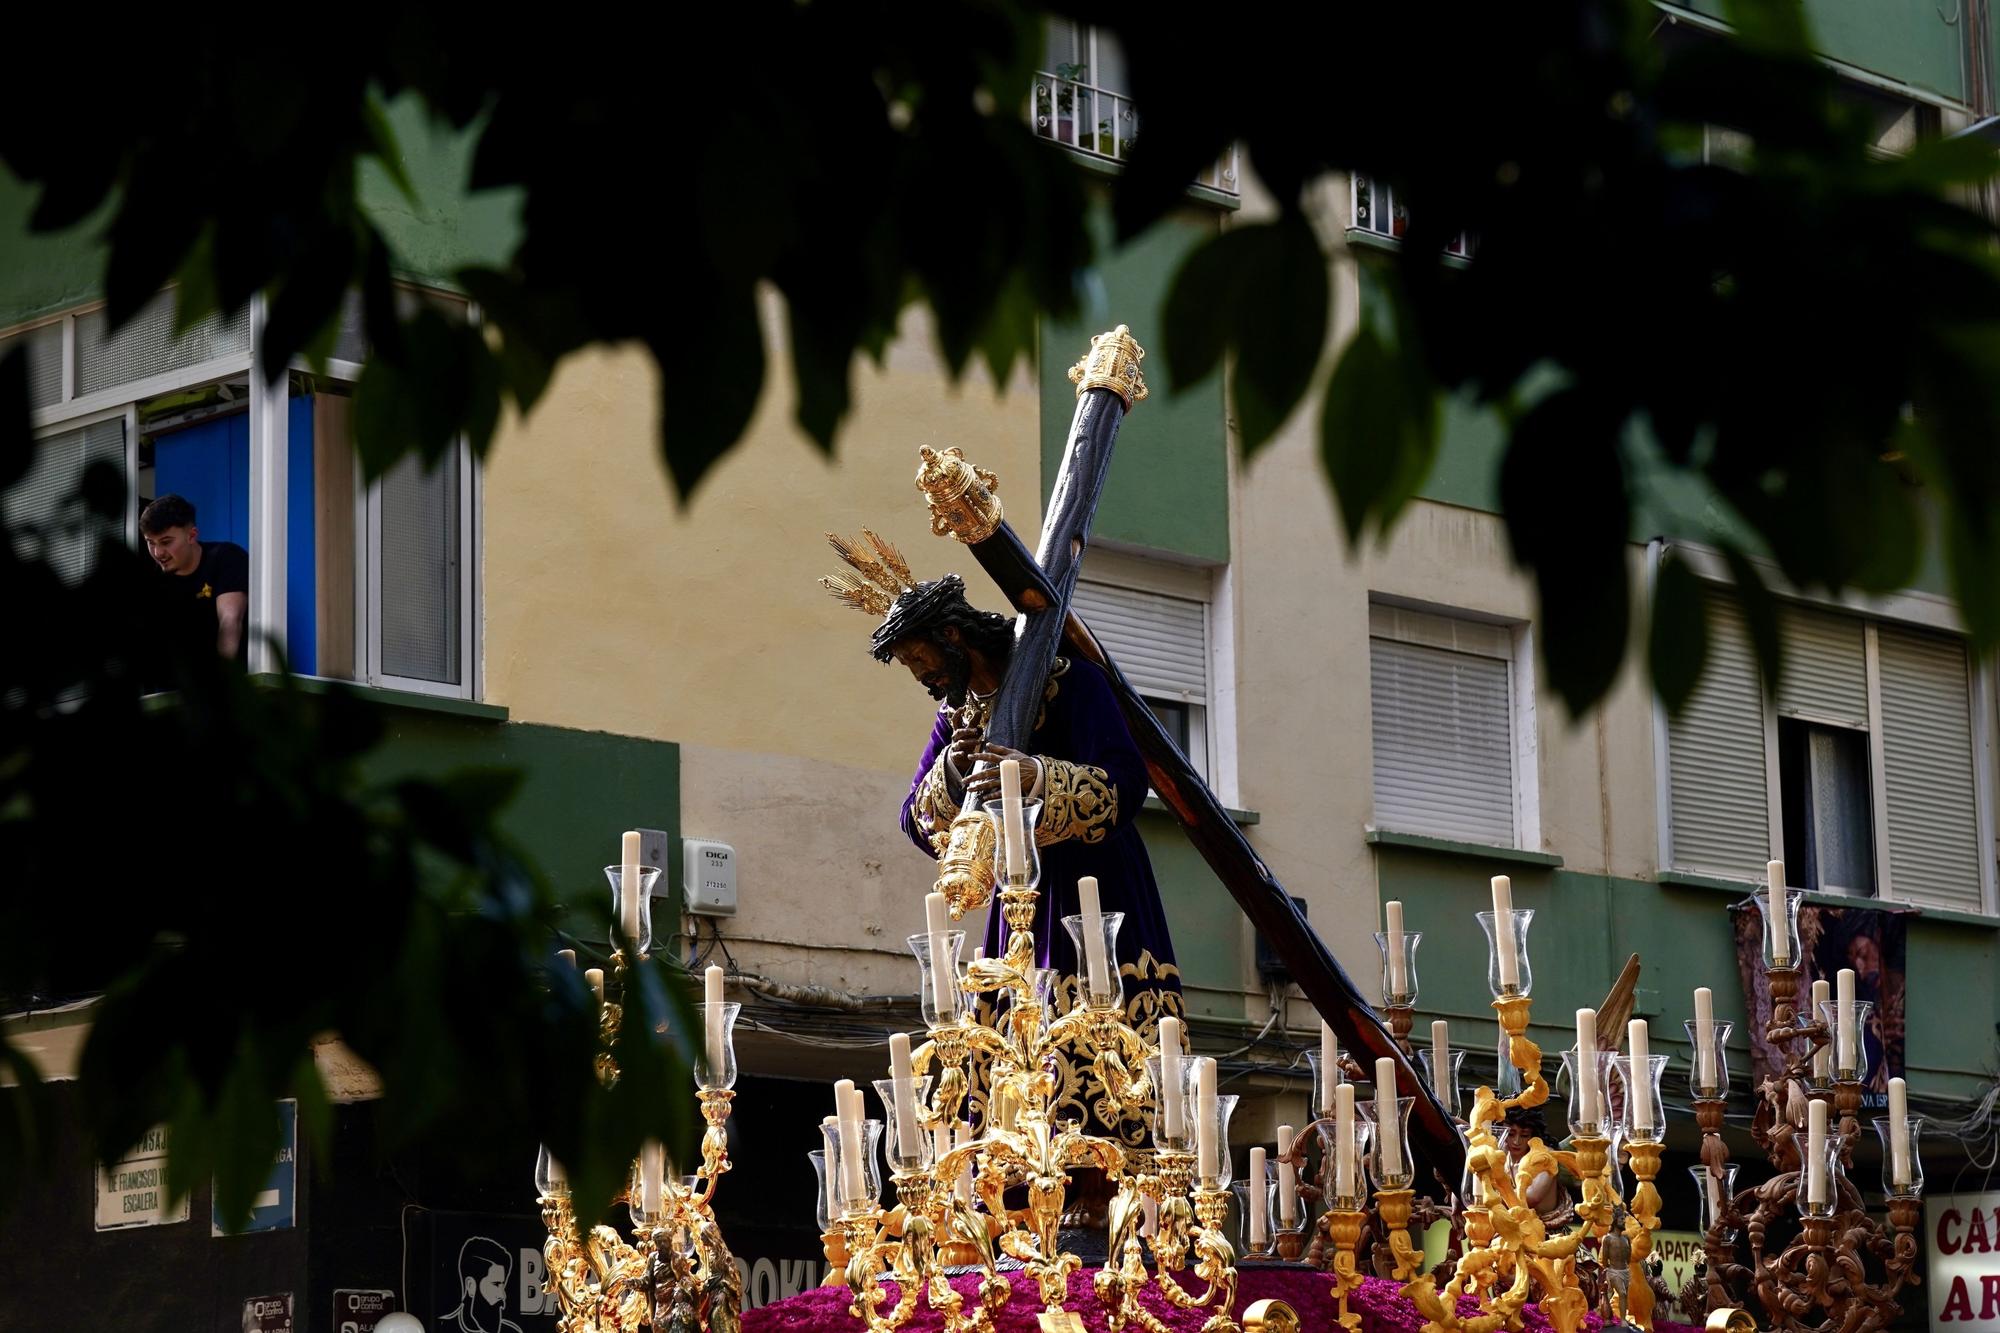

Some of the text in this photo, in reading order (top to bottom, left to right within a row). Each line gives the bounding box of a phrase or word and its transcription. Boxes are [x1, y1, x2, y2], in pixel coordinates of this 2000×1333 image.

[706, 851, 728, 860] DIGI
[135, 1127, 170, 1154] PASAJ
[108, 1175, 117, 1193] DE
[119, 1168, 158, 1192] FRANCISCO
[123, 1191, 159, 1214] ESCALERA
[1674, 1266, 1684, 1288] Y
[360, 1295, 381, 1304] grupo
[264, 1300, 282, 1310] grupo
[360, 1302, 385, 1310] control
[264, 1306, 284, 1316] control
